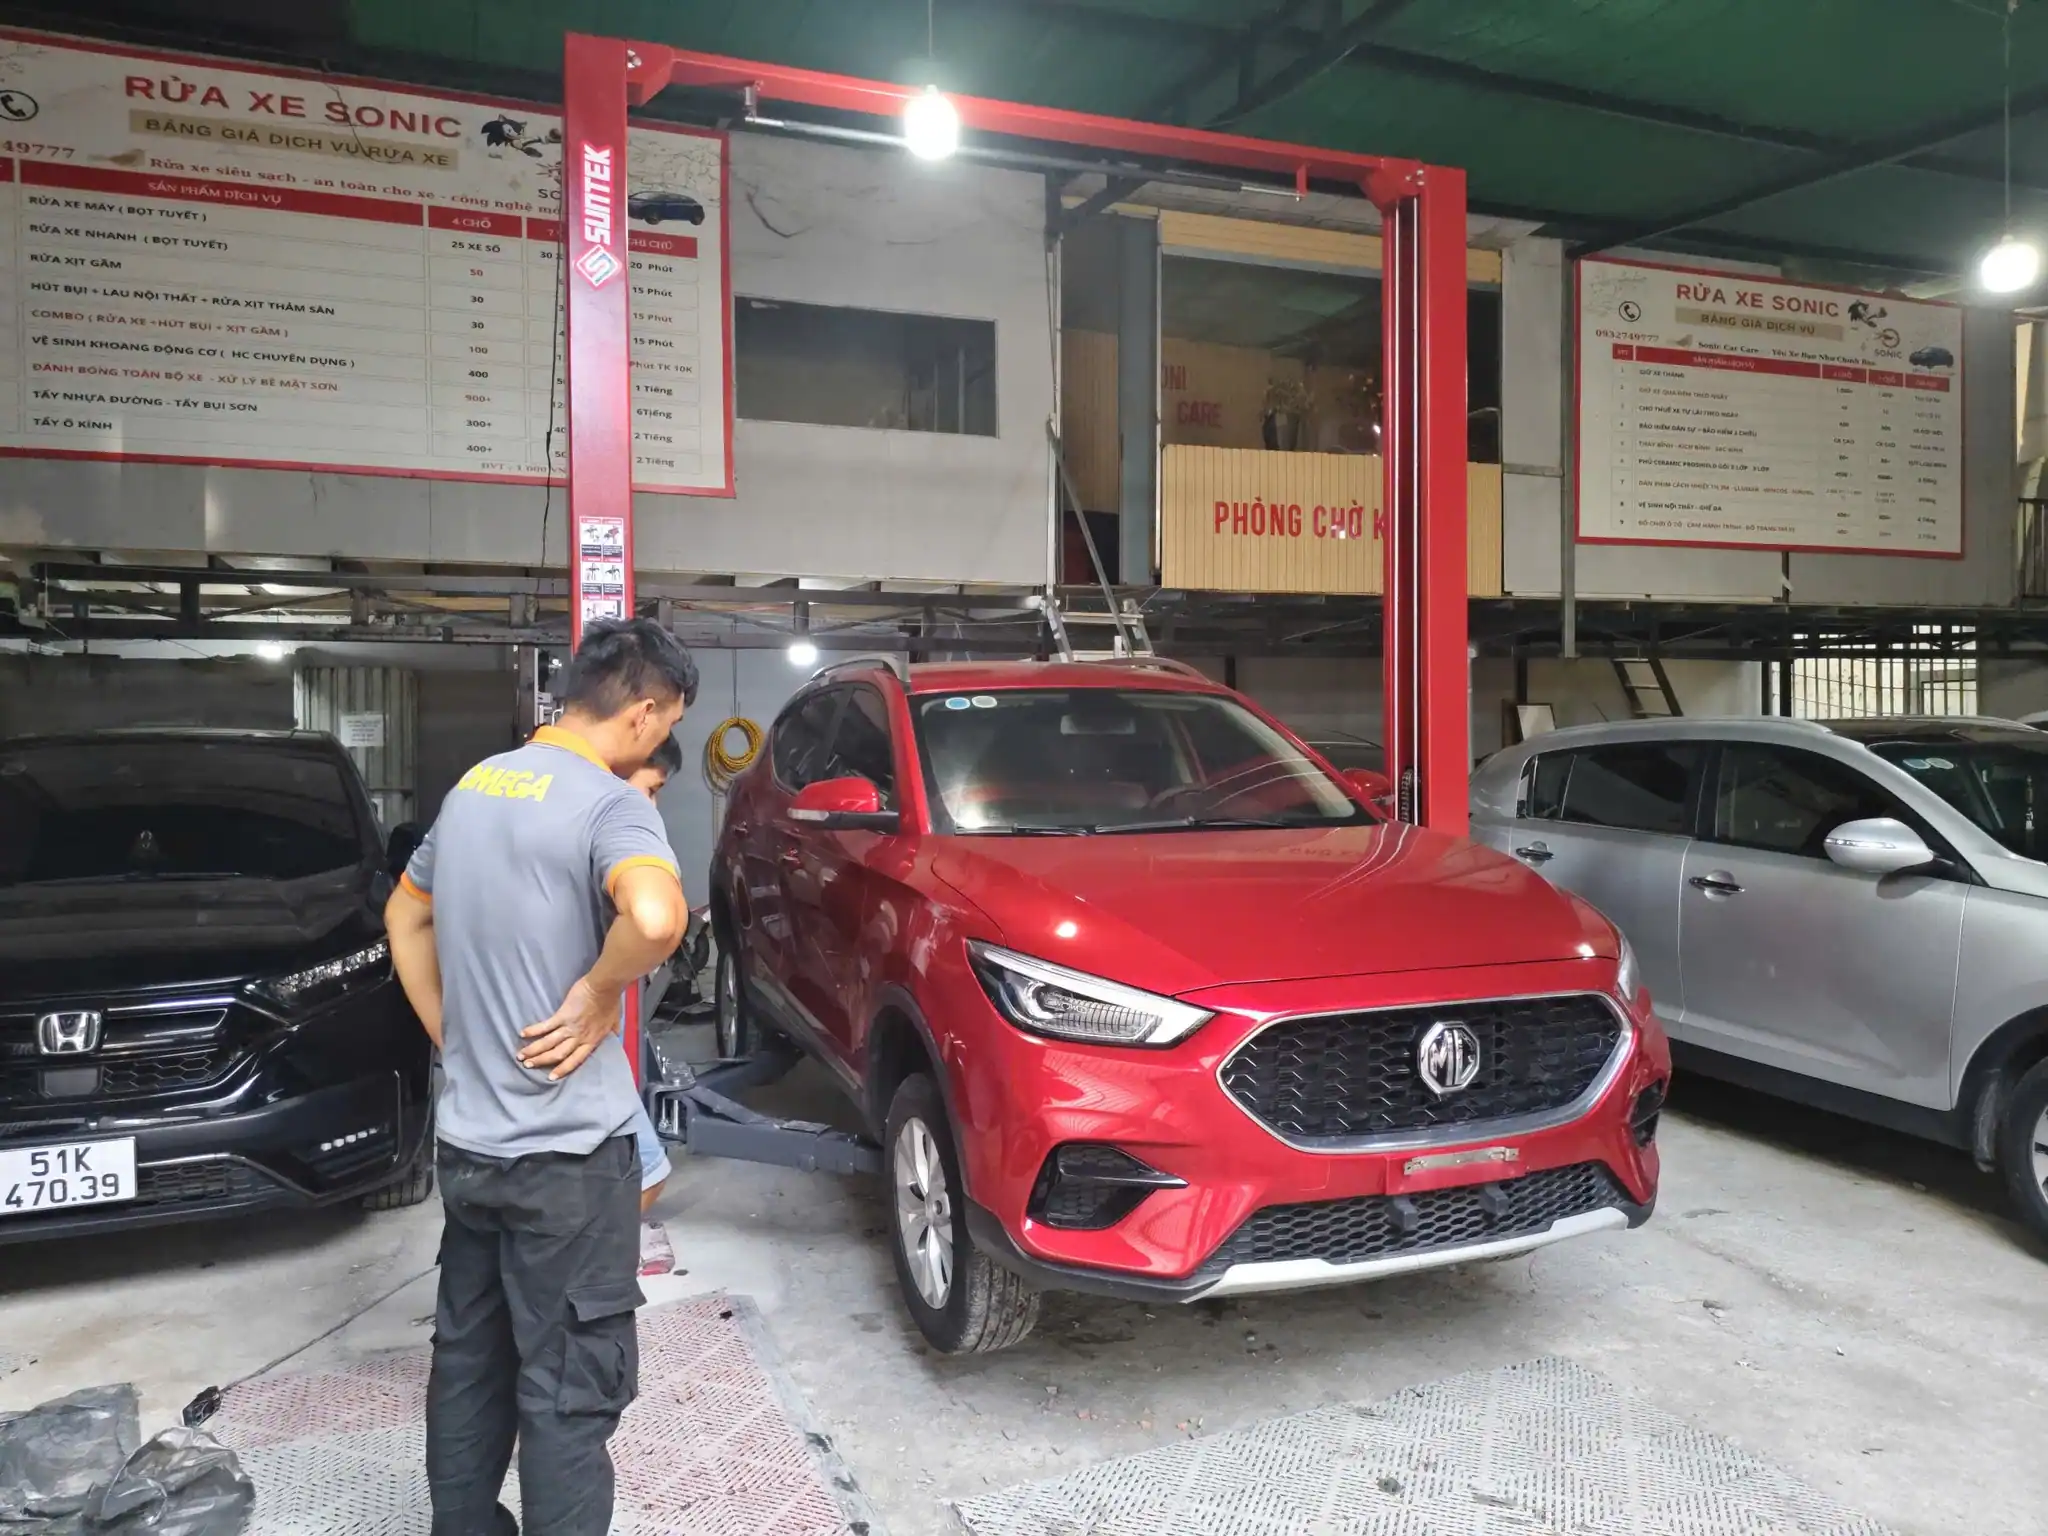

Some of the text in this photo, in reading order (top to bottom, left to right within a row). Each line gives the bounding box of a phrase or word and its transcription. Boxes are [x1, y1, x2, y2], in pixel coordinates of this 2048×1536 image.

[126, 75, 462, 138] RỬA XE SONIC
[146, 118, 212, 137] BẢNG
[221, 127, 260, 143] GIÁ
[269, 133, 322, 150] DỊCH
[423, 153, 450, 166] XE
[1, 140, 76, 159] 49777
[150, 157, 185, 171] Rửa
[191, 165, 210, 174] xe
[215, 166, 251, 178] siêu
[258, 172, 297, 185] sạch
[314, 178, 335, 187] an
[340, 180, 378, 192] toàn
[383, 186, 412, 197] cho
[417, 190, 435, 200] xe
[495, 200, 533, 213] nghệ
[584, 143, 611, 246] SUNTEK
[28, 196, 60, 208] RỬA
[64, 200, 81, 209] XE
[127, 206, 153, 217] BỌT
[158, 208, 199, 221] TUYẾT
[29, 223, 61, 235] RỬA
[65, 227, 81, 236] XE
[85, 230, 137, 242] NHANH
[152, 235, 180, 247] BỌT
[451, 240, 501, 253] 25 XE SỐ
[30, 253, 61, 265] RỬA
[64, 256, 86, 267] XỊT
[469, 268, 484, 277] 50
[630, 261, 674, 274] 20 Phút
[30, 281, 60, 292] HÚT
[64, 284, 88, 295] BỤI
[103, 287, 130, 298] LAU
[133, 289, 160, 301] NỘI
[164, 292, 198, 304] THẤT
[212, 296, 241, 308] RỬA
[244, 300, 264, 310] XỊT
[632, 286, 673, 298] 15 Phút
[471, 296, 484, 304] 30
[1676, 282, 1839, 318] RỬA XE SONIC
[31, 309, 85, 321] COMBO
[97, 312, 127, 325] RỬA
[130, 316, 147, 326] XE
[189, 321, 212, 333] BỤI
[226, 324, 246, 335] XỊT
[632, 312, 673, 324] 15 Phút
[1701, 312, 1737, 326] BẢNG
[1741, 317, 1764, 330] GIÁ
[1766, 321, 1796, 334] DỊCH
[471, 321, 485, 330] 30
[633, 337, 675, 349] 15 Phút
[1723, 344, 1738, 353] Car
[1740, 345, 1760, 355] Care
[31, 335, 347, 368] VỆ SINH KHOANG ĐỘNG CƠ HC CHUYÊN DỤNG
[468, 346, 488, 355] 100
[1788, 350, 1800, 359] Xe
[1874, 348, 1903, 361] SONIC
[32, 362, 74, 374] ĐÁNH
[78, 365, 118, 377] BÓNG
[164, 369, 184, 382] BỘ
[187, 373, 203, 382] XE
[217, 373, 239, 384] XỬ
[310, 381, 338, 392] SƠN
[468, 370, 489, 379] 400
[635, 384, 673, 397] 1 Tiếng
[63, 391, 106, 403] NHỰA
[110, 393, 164, 407] ĐƯỜNG
[203, 400, 226, 411] BỤI
[229, 401, 258, 413] SƠN
[464, 394, 491, 403] 900+
[78, 418, 112, 430] KÍNH
[466, 419, 492, 428] 300+
[634, 432, 673, 445] 2 Tiếng
[466, 445, 493, 453] 400+
[635, 456, 675, 469] 2 Tiếng
[1215, 496, 1302, 537] PHÒNG
[1313, 499, 1364, 540] CHỜ
[31, 1146, 93, 1178] 51K
[5, 1172, 120, 1209] 470.39
